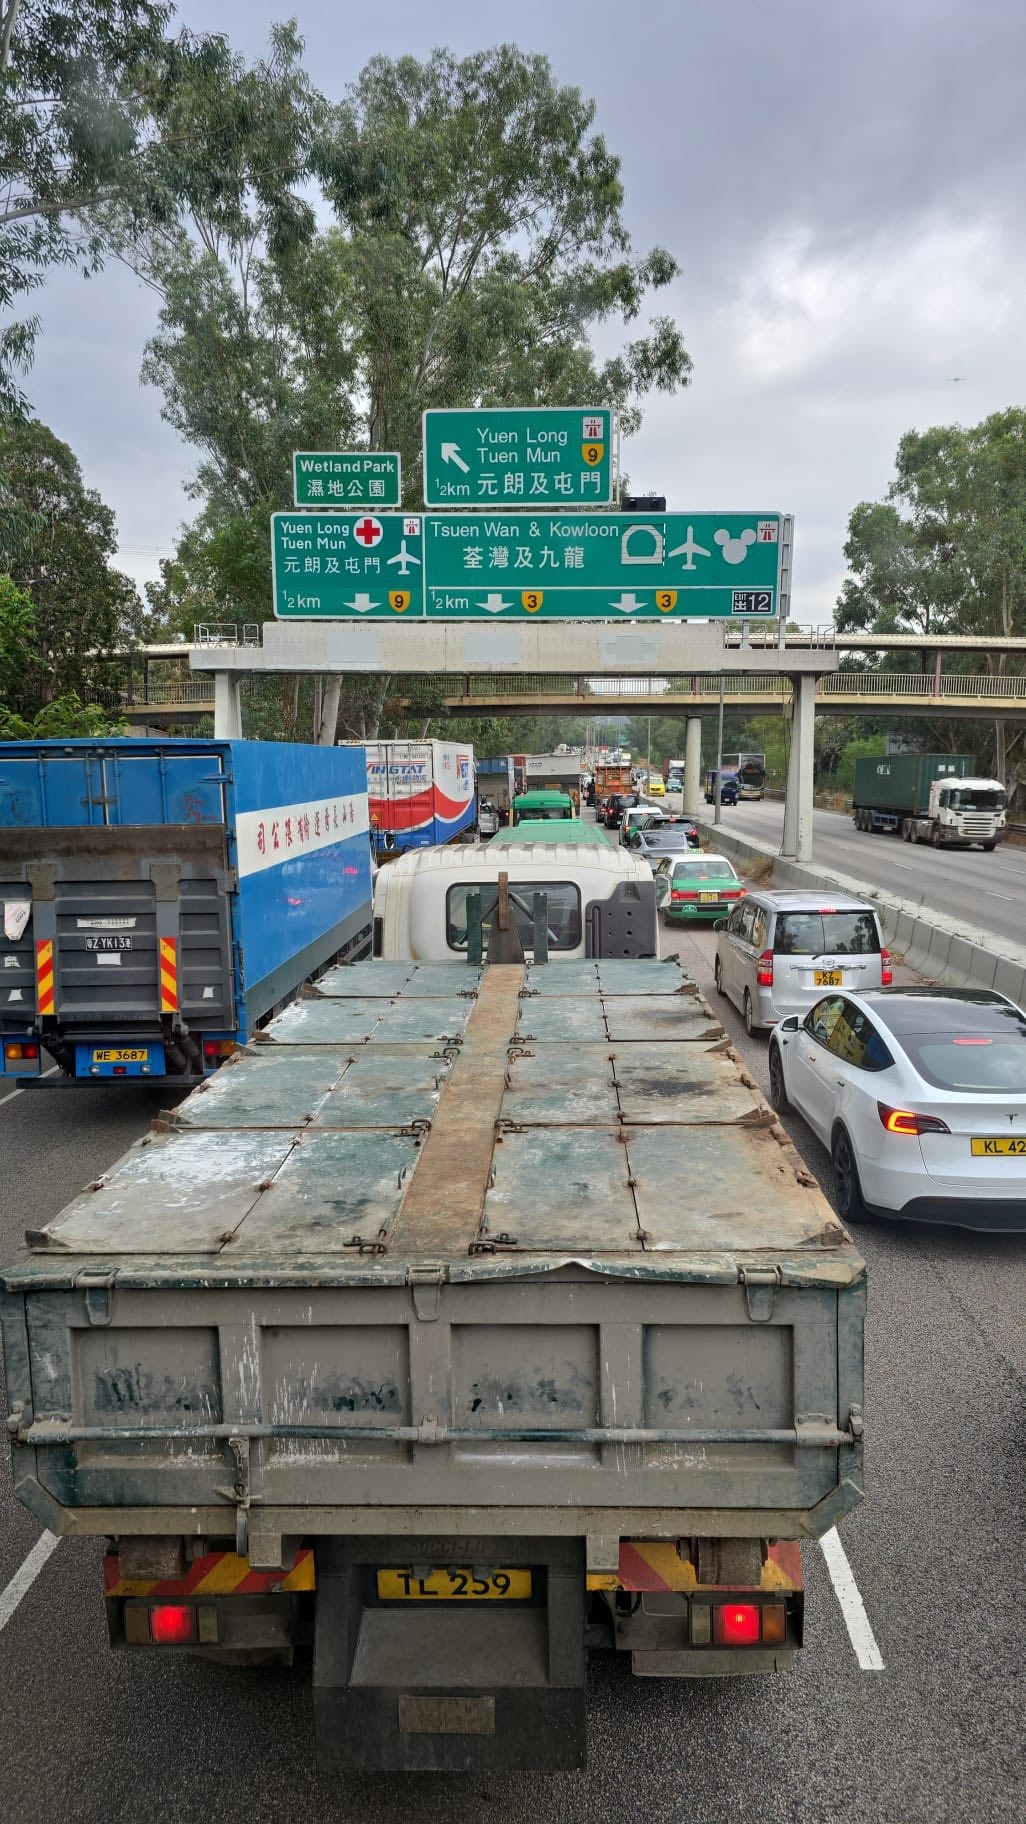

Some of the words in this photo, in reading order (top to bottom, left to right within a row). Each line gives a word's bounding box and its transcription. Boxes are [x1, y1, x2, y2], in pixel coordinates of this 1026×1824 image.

[476, 427, 518, 444] Yuen
[526, 427, 568, 448] Long
[476, 447, 518, 464] Tuen
[526, 447, 561, 464] Mun
[587, 448, 598, 463] 9
[300, 459, 361, 473] Wetland
[363, 460, 395, 473] Park
[307, 479, 385, 497] 濕地公園
[477, 471, 601, 496] 元朗及屯門
[280, 521, 314, 535] Yuen
[317, 521, 349, 538] Long
[430, 521, 479, 537] Tsuen
[483, 521, 519, 537] Wan
[528, 521, 541, 537] &
[549, 521, 619, 537] Kowloon
[280, 537, 313, 550] Tuen
[317, 537, 346, 550] Mun
[462, 545, 585, 569] 荃灣及九龍
[283, 556, 381, 574] 元朗及屯門
[394, 594, 404, 609] 9
[527, 594, 538, 609] 3
[660, 594, 672, 609] 3
[734, 593, 747, 601] EXIT
[748, 594, 769, 611] 12
[816, 978, 840, 986] 7687
[822, 971, 834, 979] KZ
[96, 1051, 111, 1060] WE
[115, 1051, 145, 1060] 3687
[984, 1140, 1003, 1153] KL
[397, 1574, 438, 1595] TL
[449, 1573, 511, 1595] 259
